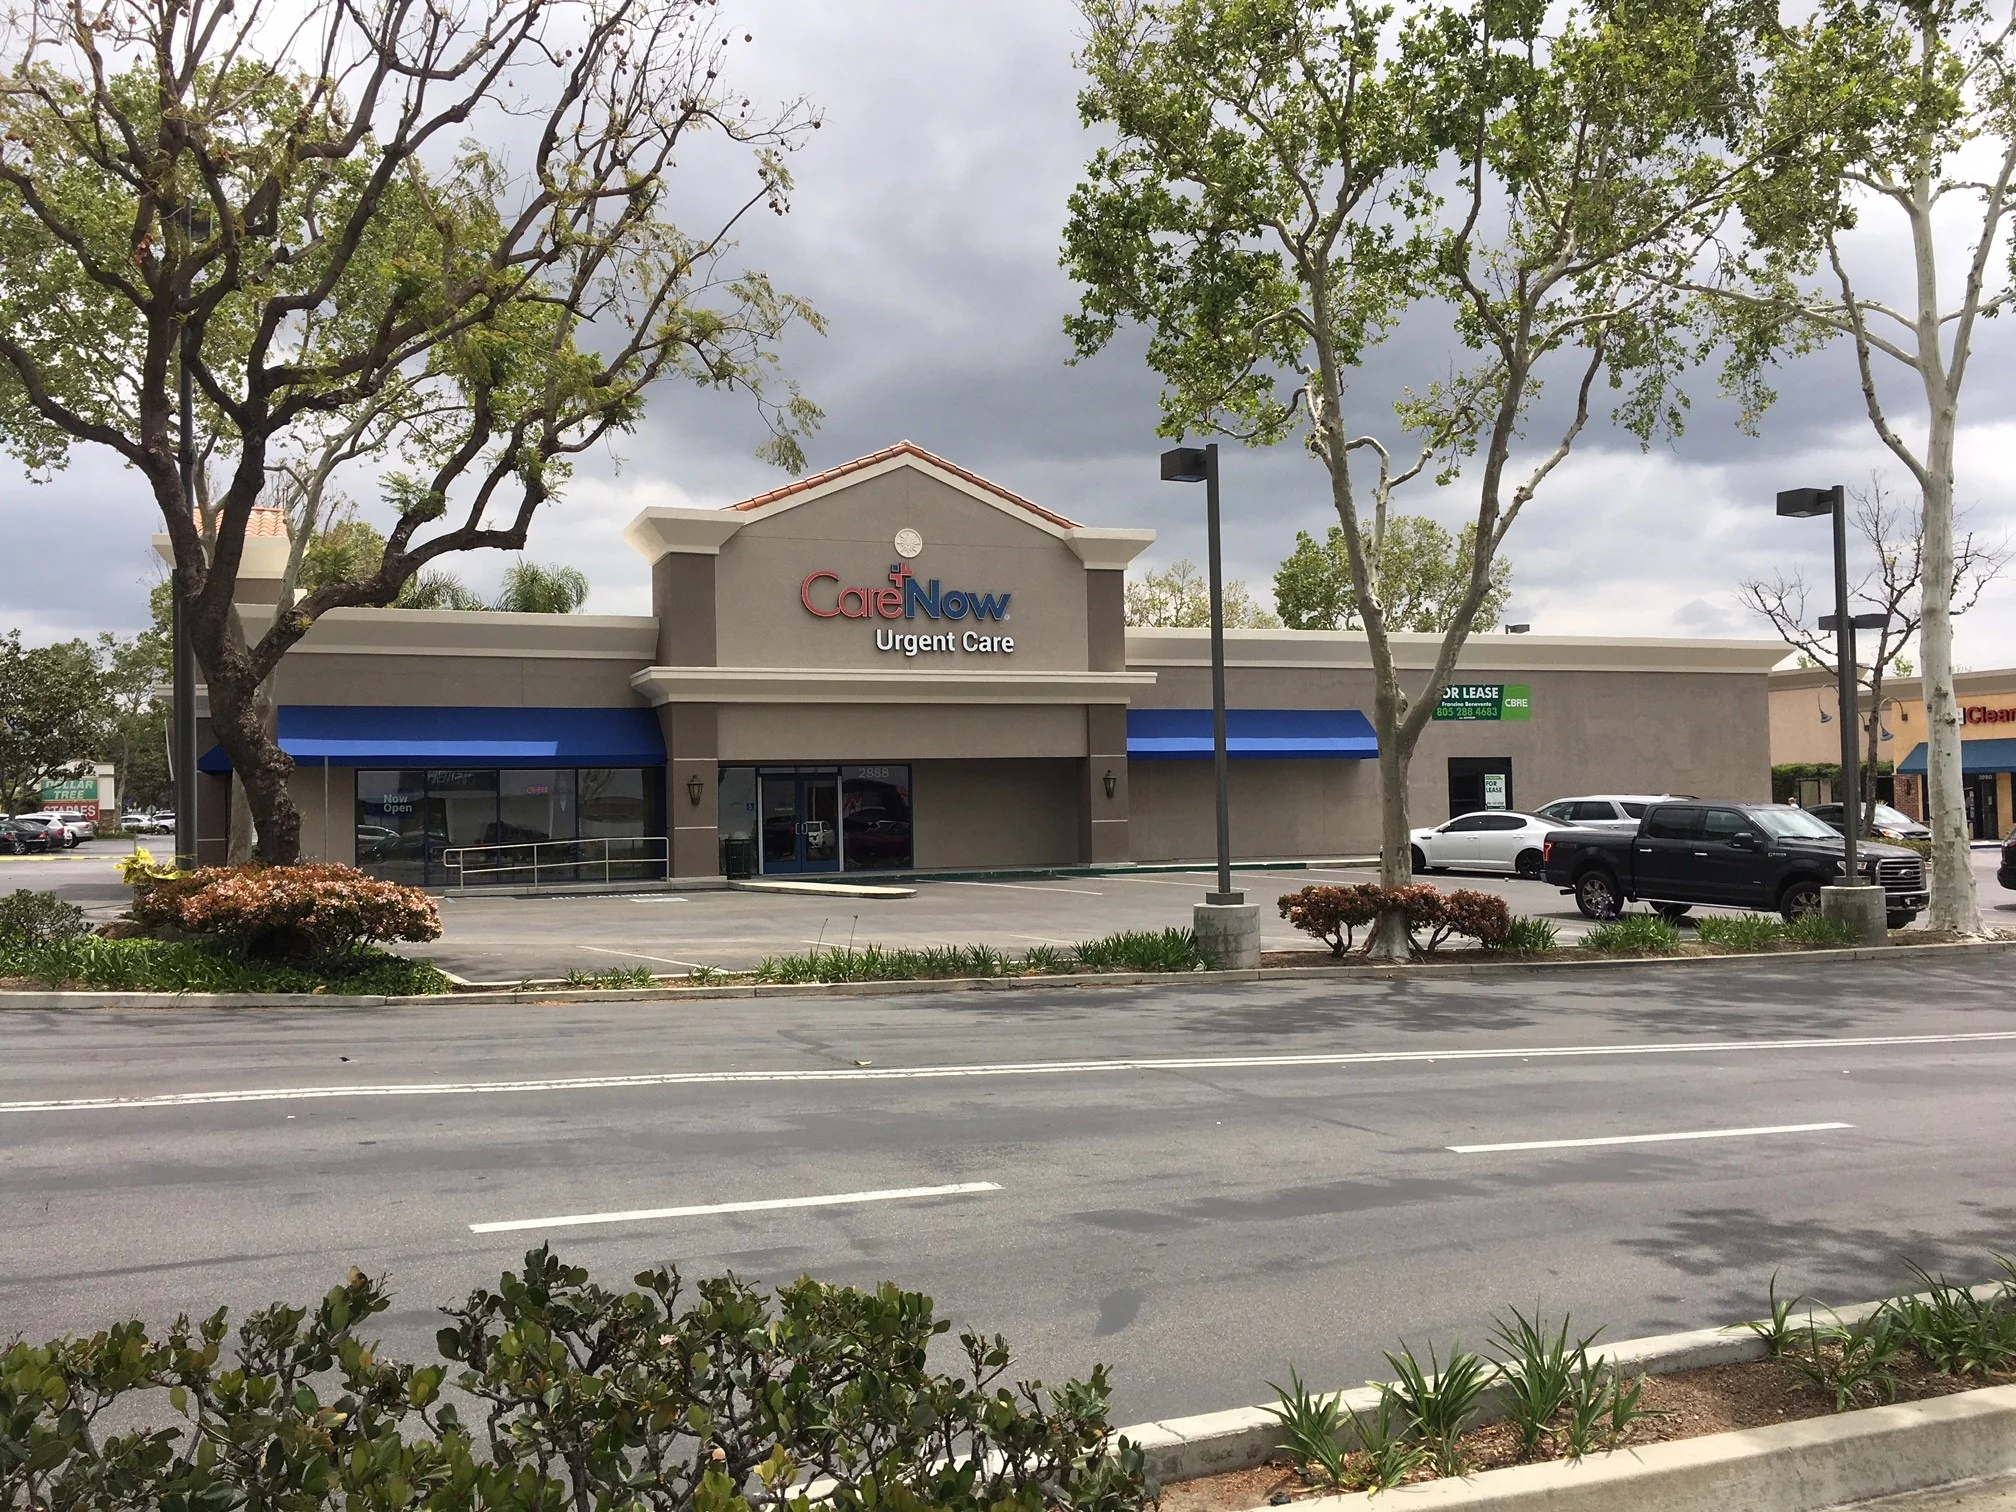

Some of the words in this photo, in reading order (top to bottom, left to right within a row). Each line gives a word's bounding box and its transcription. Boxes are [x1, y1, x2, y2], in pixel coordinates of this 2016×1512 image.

[876, 628, 956, 656] Urgent
[962, 630, 1015, 653] Care
[1442, 687, 1459, 699] OR
[1462, 687, 1499, 699] LEASE
[1505, 699, 1528, 707] CBRE
[1436, 707, 1454, 716] 805
[1456, 707, 1473, 716] 288
[1475, 707, 1498, 716] 4683
[858, 767, 890, 778] 2888
[45, 780, 94, 790] DOLLAR
[526, 785, 548, 795] OPEN
[53, 790, 85, 800] TREE
[383, 794, 408, 804] Now
[383, 803, 413, 815] Open
